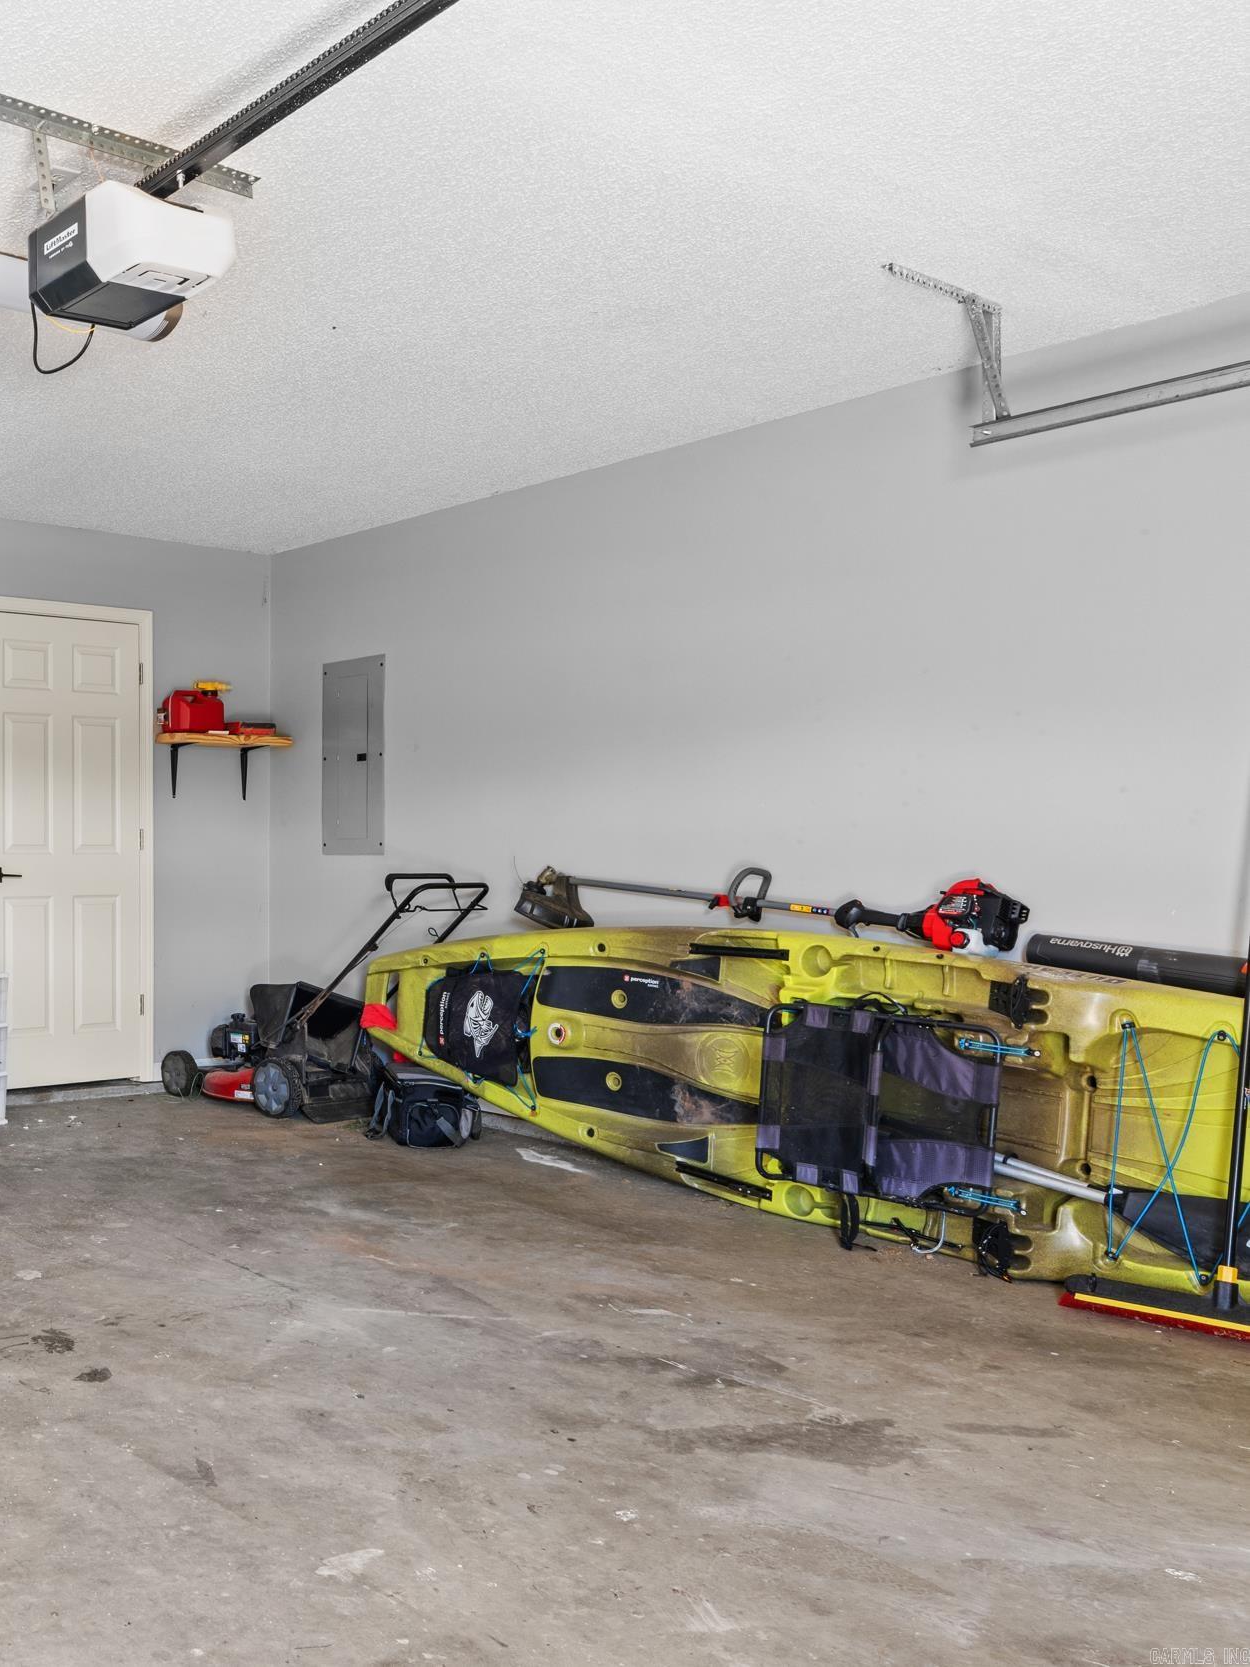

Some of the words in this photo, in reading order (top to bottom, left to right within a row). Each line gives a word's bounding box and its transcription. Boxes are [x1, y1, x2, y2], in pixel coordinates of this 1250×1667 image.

[45, 228, 75, 251] LiftMaster
[1049, 937, 1118, 954] Husqvarna
[439, 992, 447, 1034] perception
